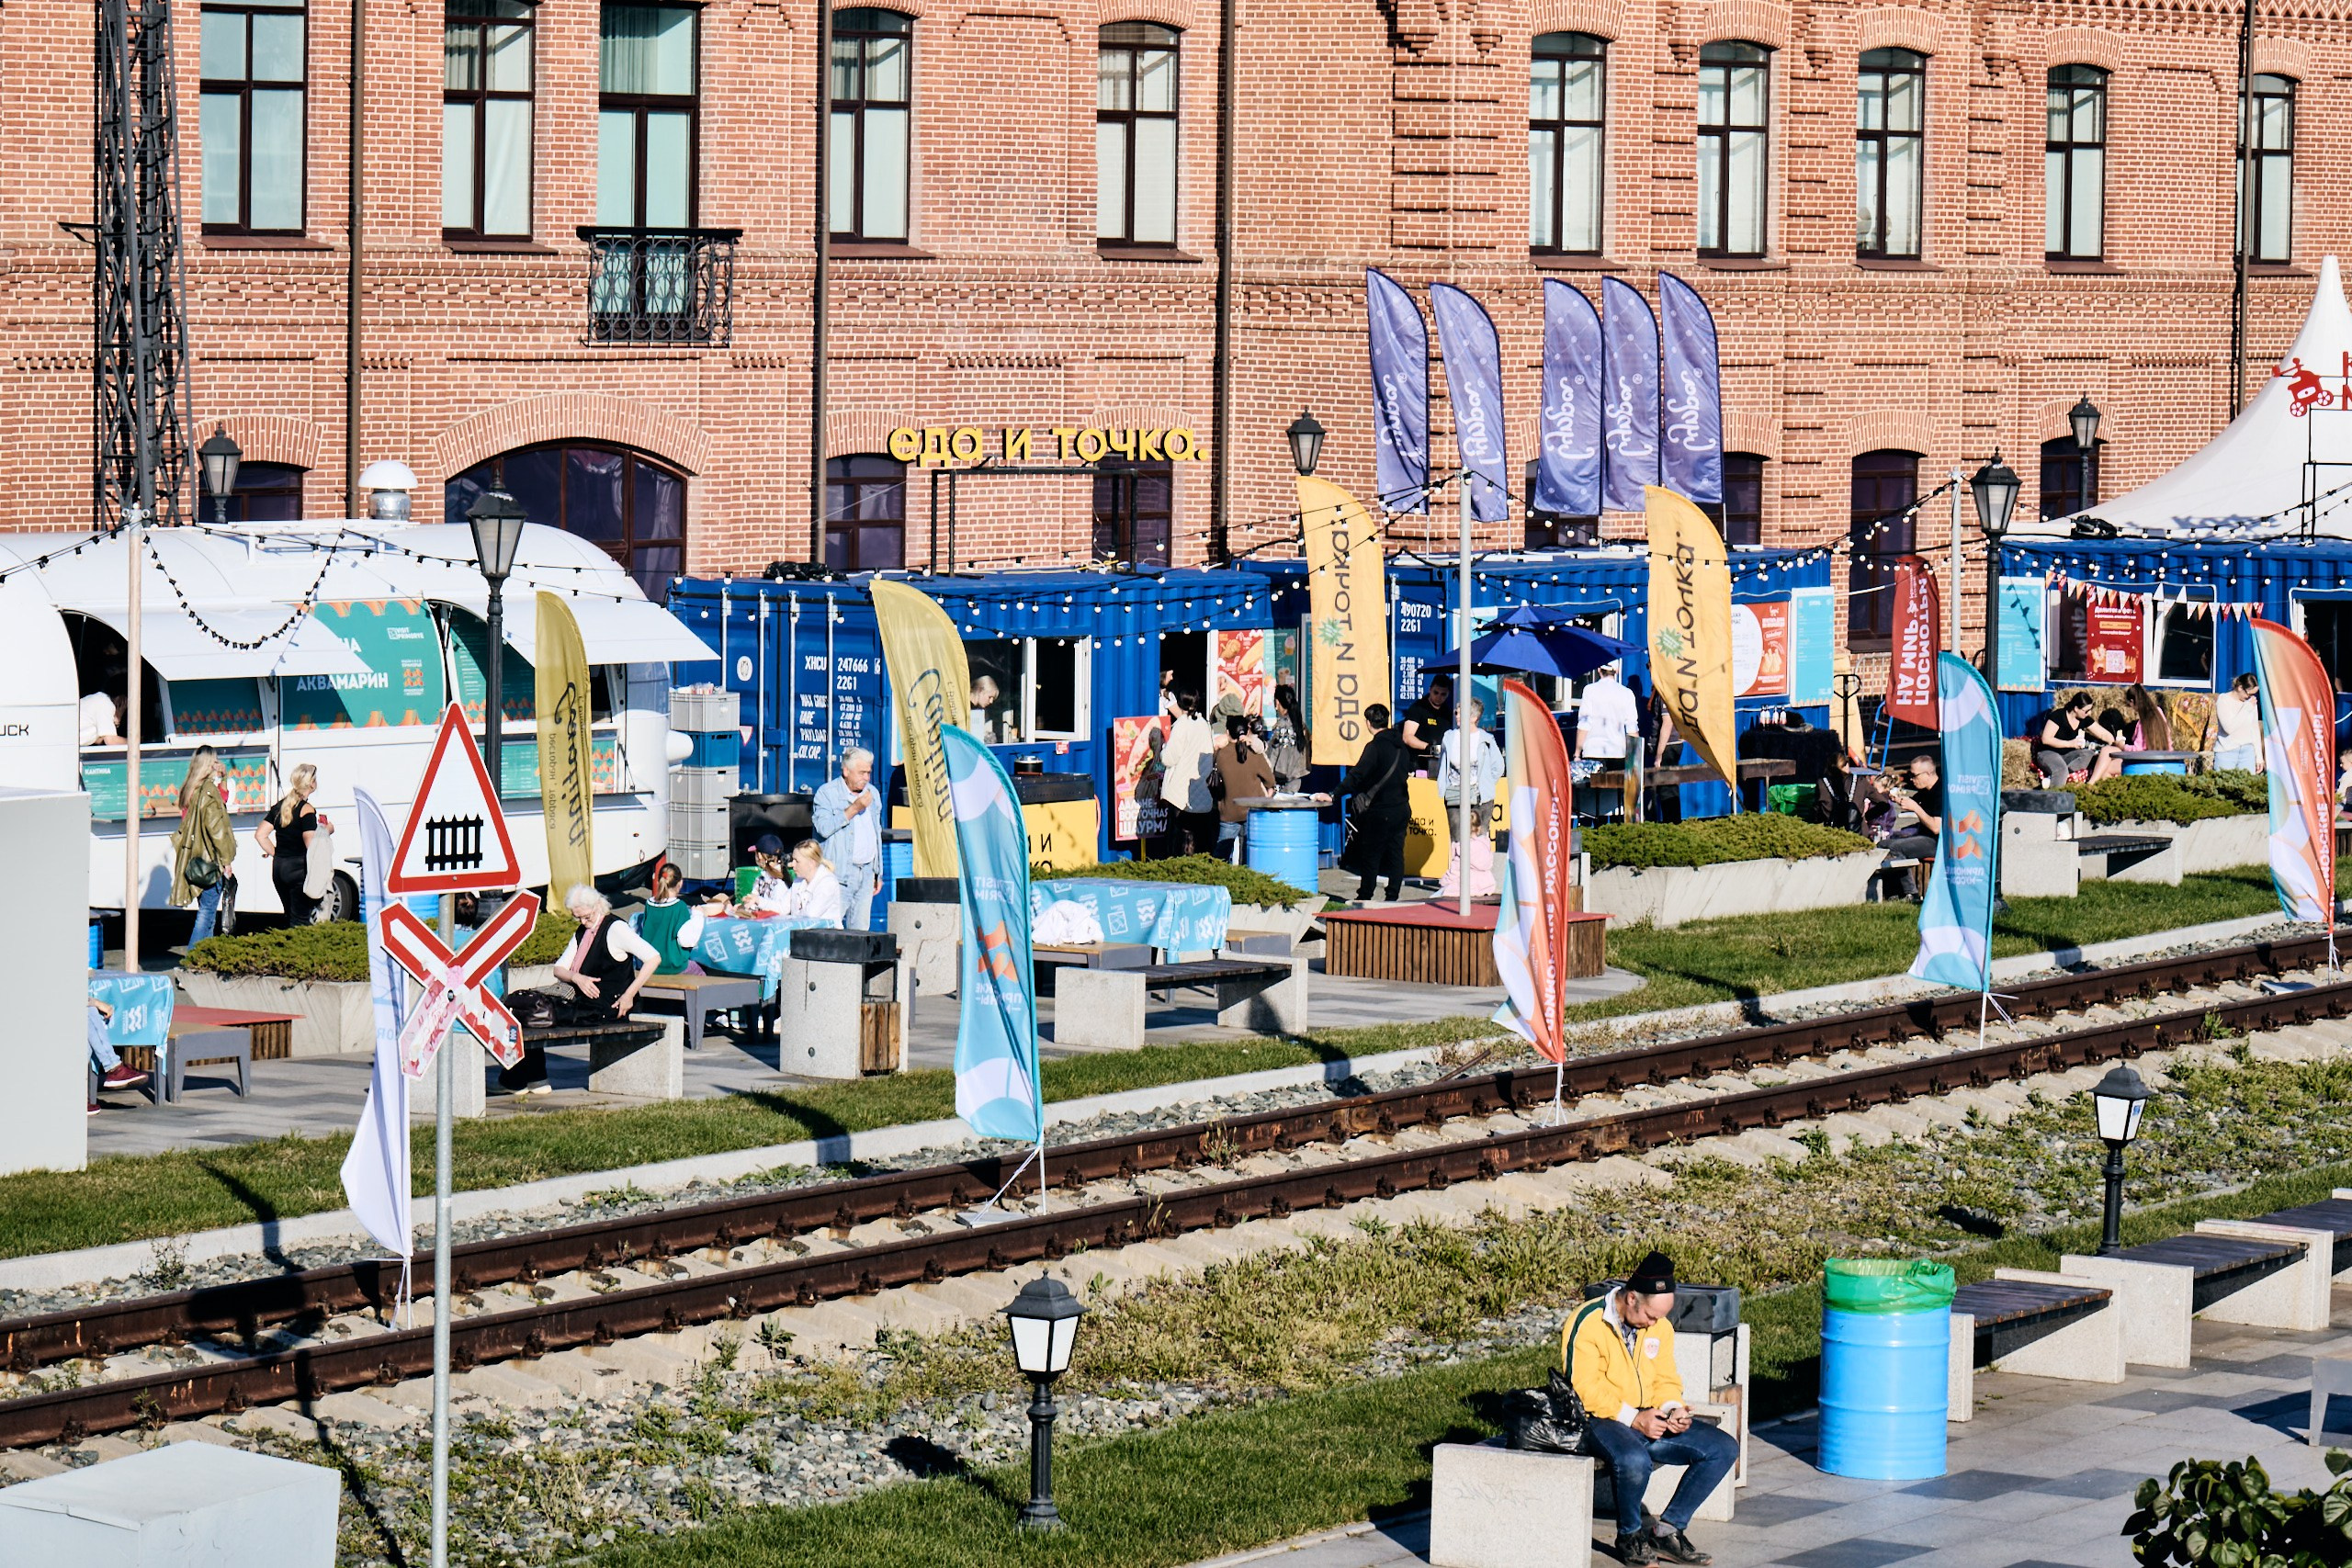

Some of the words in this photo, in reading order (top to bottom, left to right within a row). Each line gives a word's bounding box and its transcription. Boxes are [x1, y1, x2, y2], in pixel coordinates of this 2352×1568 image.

[888, 427, 983, 468] еда
[1004, 428, 1032, 461] и
[1050, 427, 1210, 463] точка.
[1400, 602, 1432, 618] 490720
[1400, 619, 1421, 632] 22G1
[805, 655, 828, 671] XHCU
[837, 658, 869, 673] 247666
[296, 672, 389, 692] АКВАМАРИН
[837, 676, 858, 691] 22G1
[1408, 818, 1426, 827] еда
[1428, 818, 1434, 826] и
[1408, 826, 1437, 837] точка.
